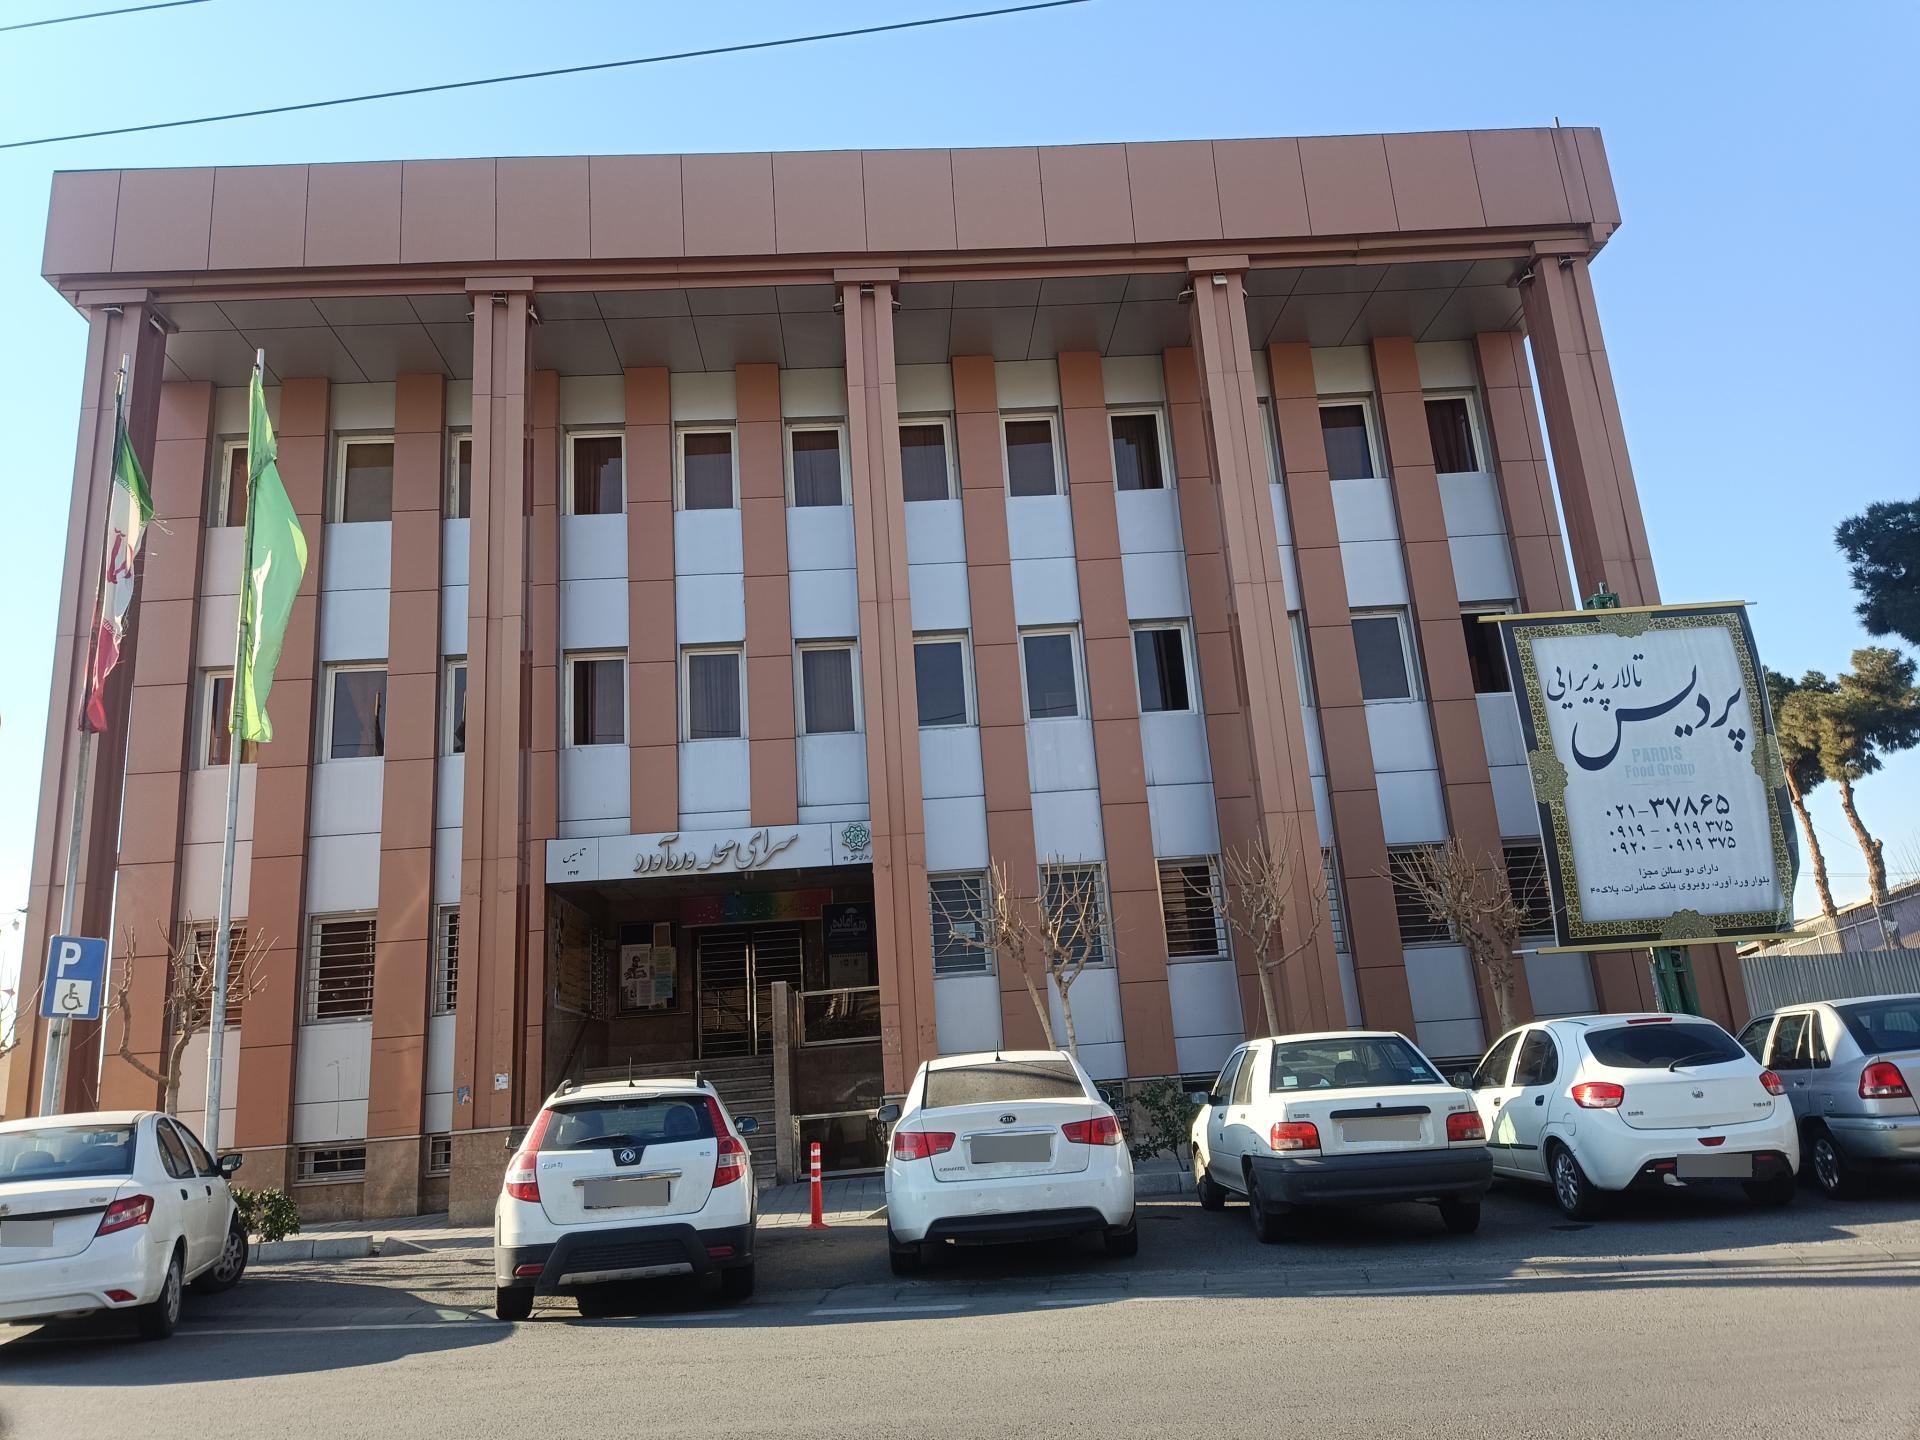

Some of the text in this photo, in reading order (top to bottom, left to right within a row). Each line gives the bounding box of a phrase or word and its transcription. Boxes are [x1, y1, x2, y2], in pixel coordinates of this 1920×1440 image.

[1546, 653, 1644, 712] تالار پذیرایی
[1571, 664, 1746, 772] پردیس
[1631, 746, 1683, 763] PARDIS
[1624, 762, 1696, 779] Food Group
[697, 839, 736, 871] محله
[735, 828, 799, 869] سرای
[1638, 864, 1719, 878] دارای دو سالن مجزا
[1657, 882, 1677, 892] بانک
[1678, 880, 1710, 891] روبروی
[1750, 875, 1770, 887] بلوار
[57, 941, 82, 978] P
[1001, 1115, 1014, 1123] KIA
